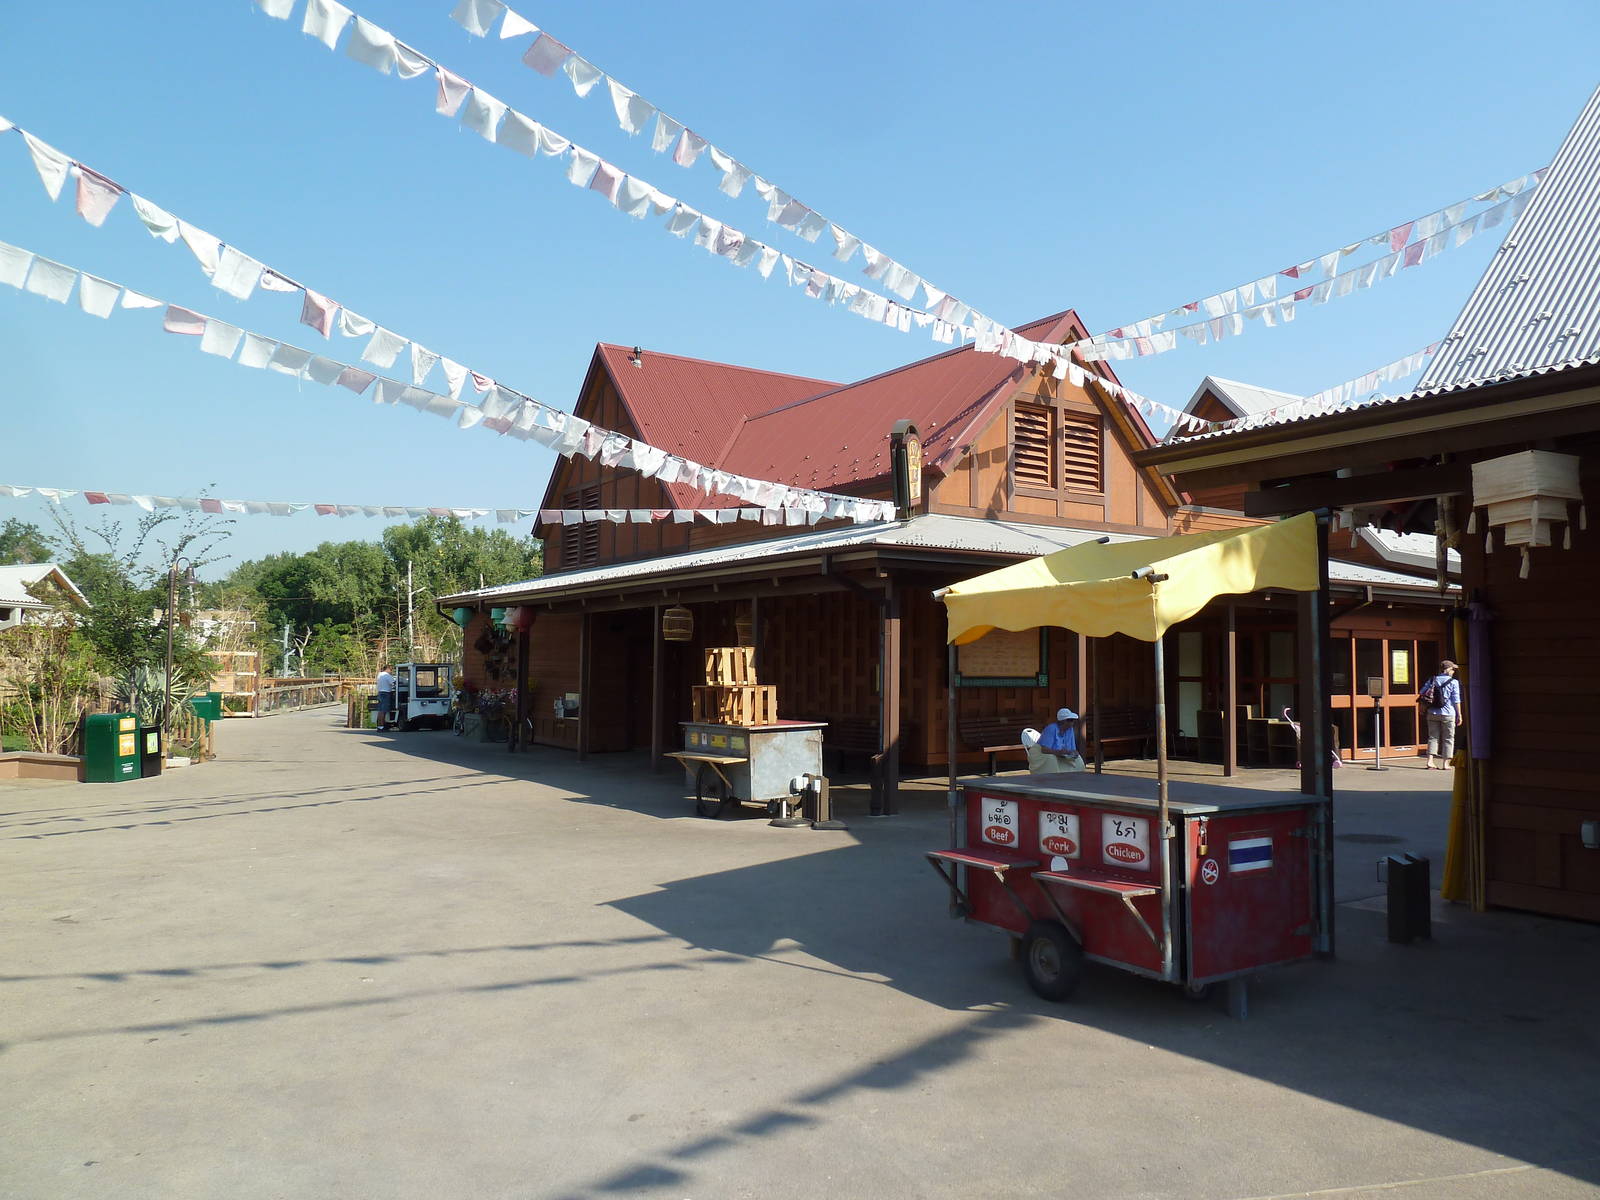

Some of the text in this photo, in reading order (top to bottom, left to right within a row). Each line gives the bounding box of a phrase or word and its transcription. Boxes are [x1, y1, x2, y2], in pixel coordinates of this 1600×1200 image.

[990, 828, 1009, 842] Beef
[1048, 839, 1070, 853] Pork
[1108, 845, 1141, 861] Chicken
